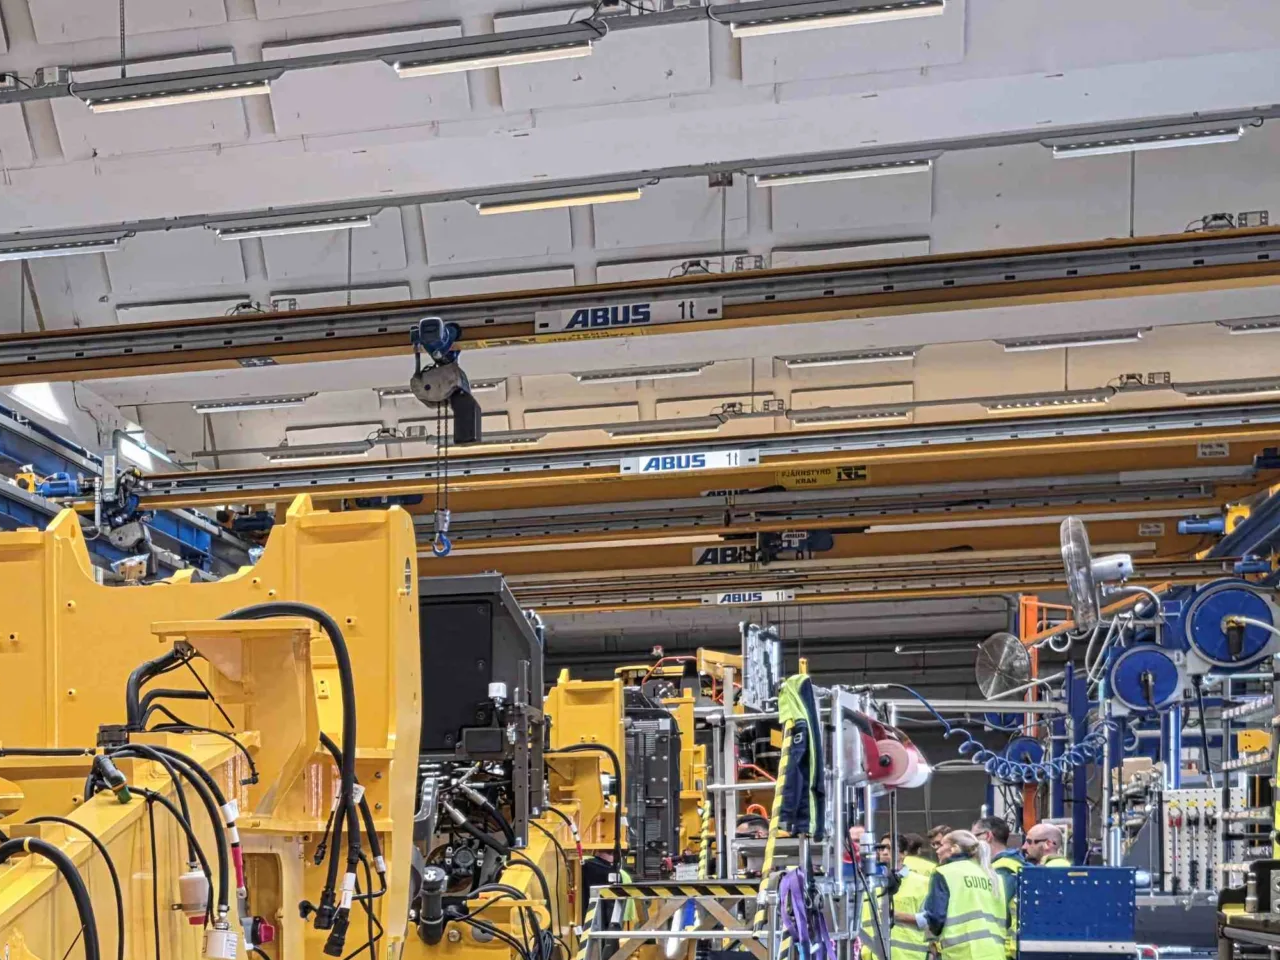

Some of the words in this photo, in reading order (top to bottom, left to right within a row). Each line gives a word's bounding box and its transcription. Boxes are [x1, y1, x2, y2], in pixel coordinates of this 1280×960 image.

[565, 303, 650, 329] ABUS
[678, 301, 695, 319] 1t
[643, 454, 706, 471] ABUS
[726, 452, 738, 466] 1t
[720, 592, 763, 603] ABUS
